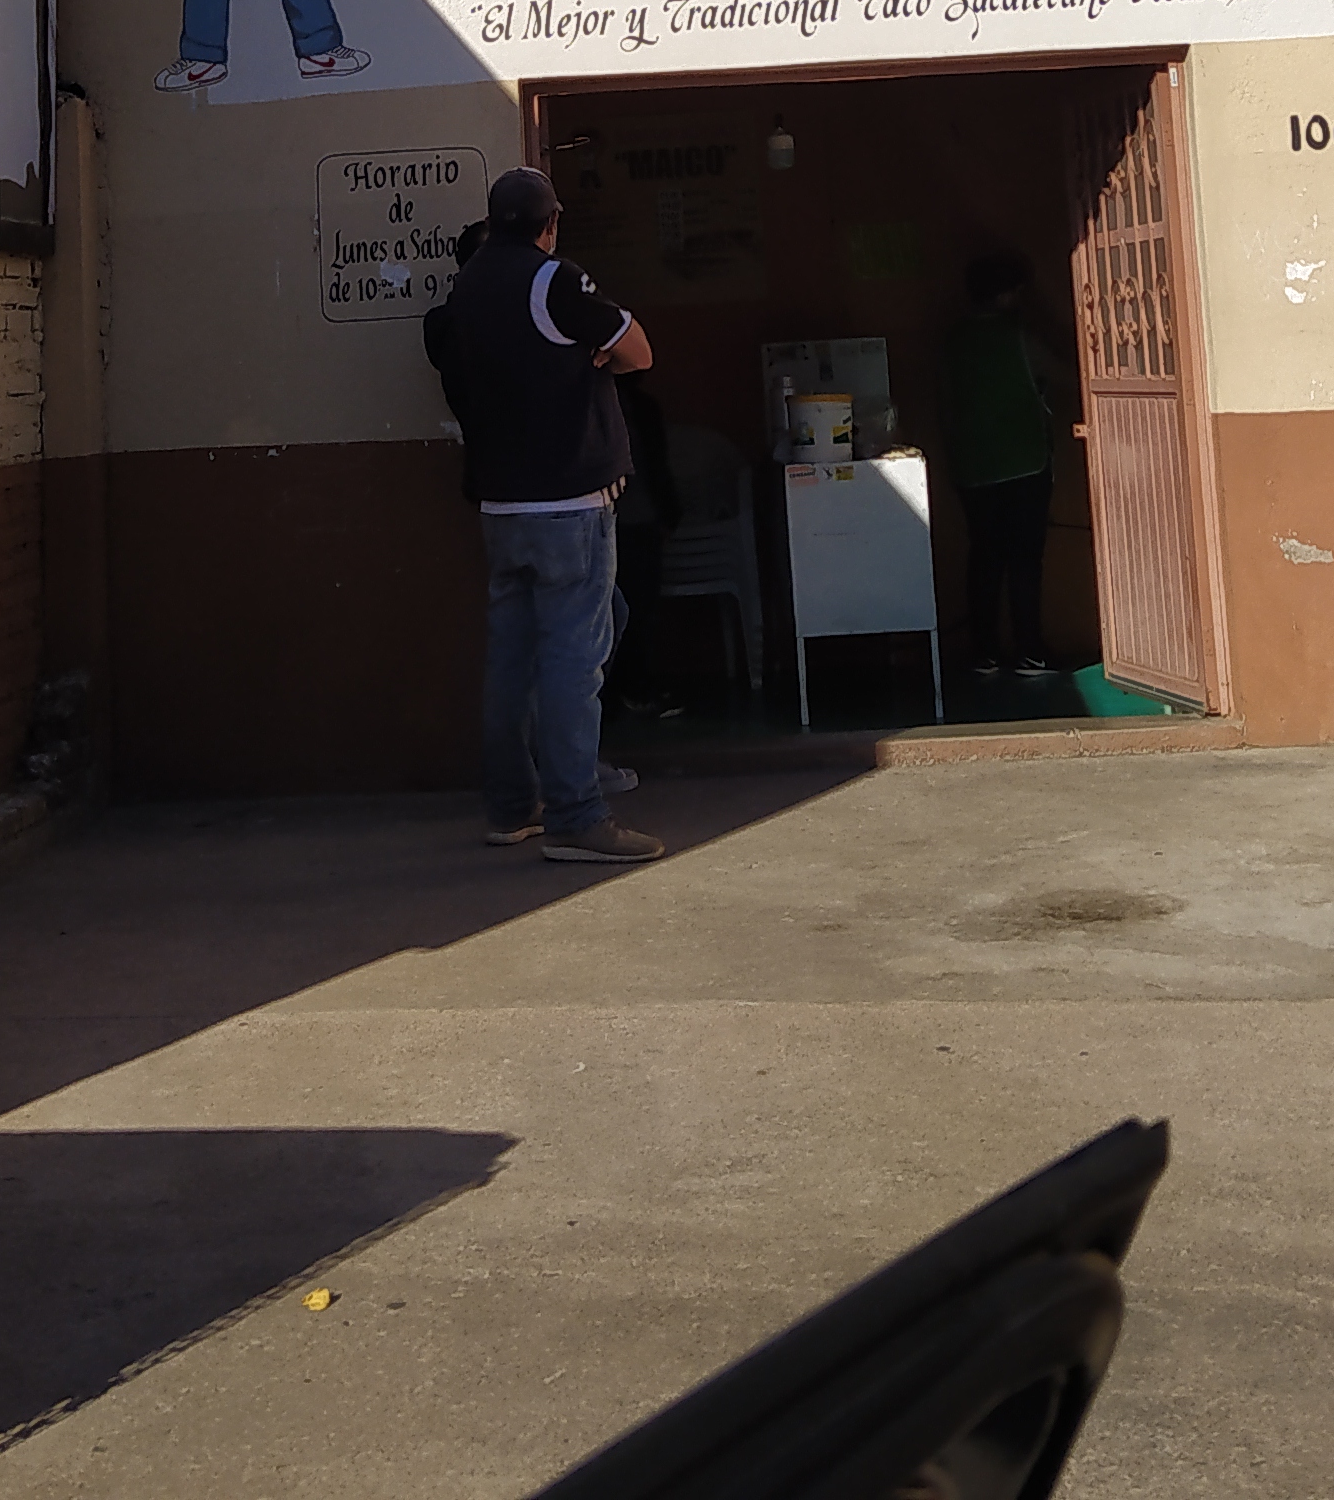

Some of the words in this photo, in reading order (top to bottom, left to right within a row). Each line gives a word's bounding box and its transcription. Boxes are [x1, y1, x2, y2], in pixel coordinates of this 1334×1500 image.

[618, 4, 661, 54] y
[343, 153, 460, 193] Horario
[387, 191, 415, 225] de
[329, 228, 389, 271] Lunes
[393, 238, 409, 262] a
[328, 271, 352, 304] de
